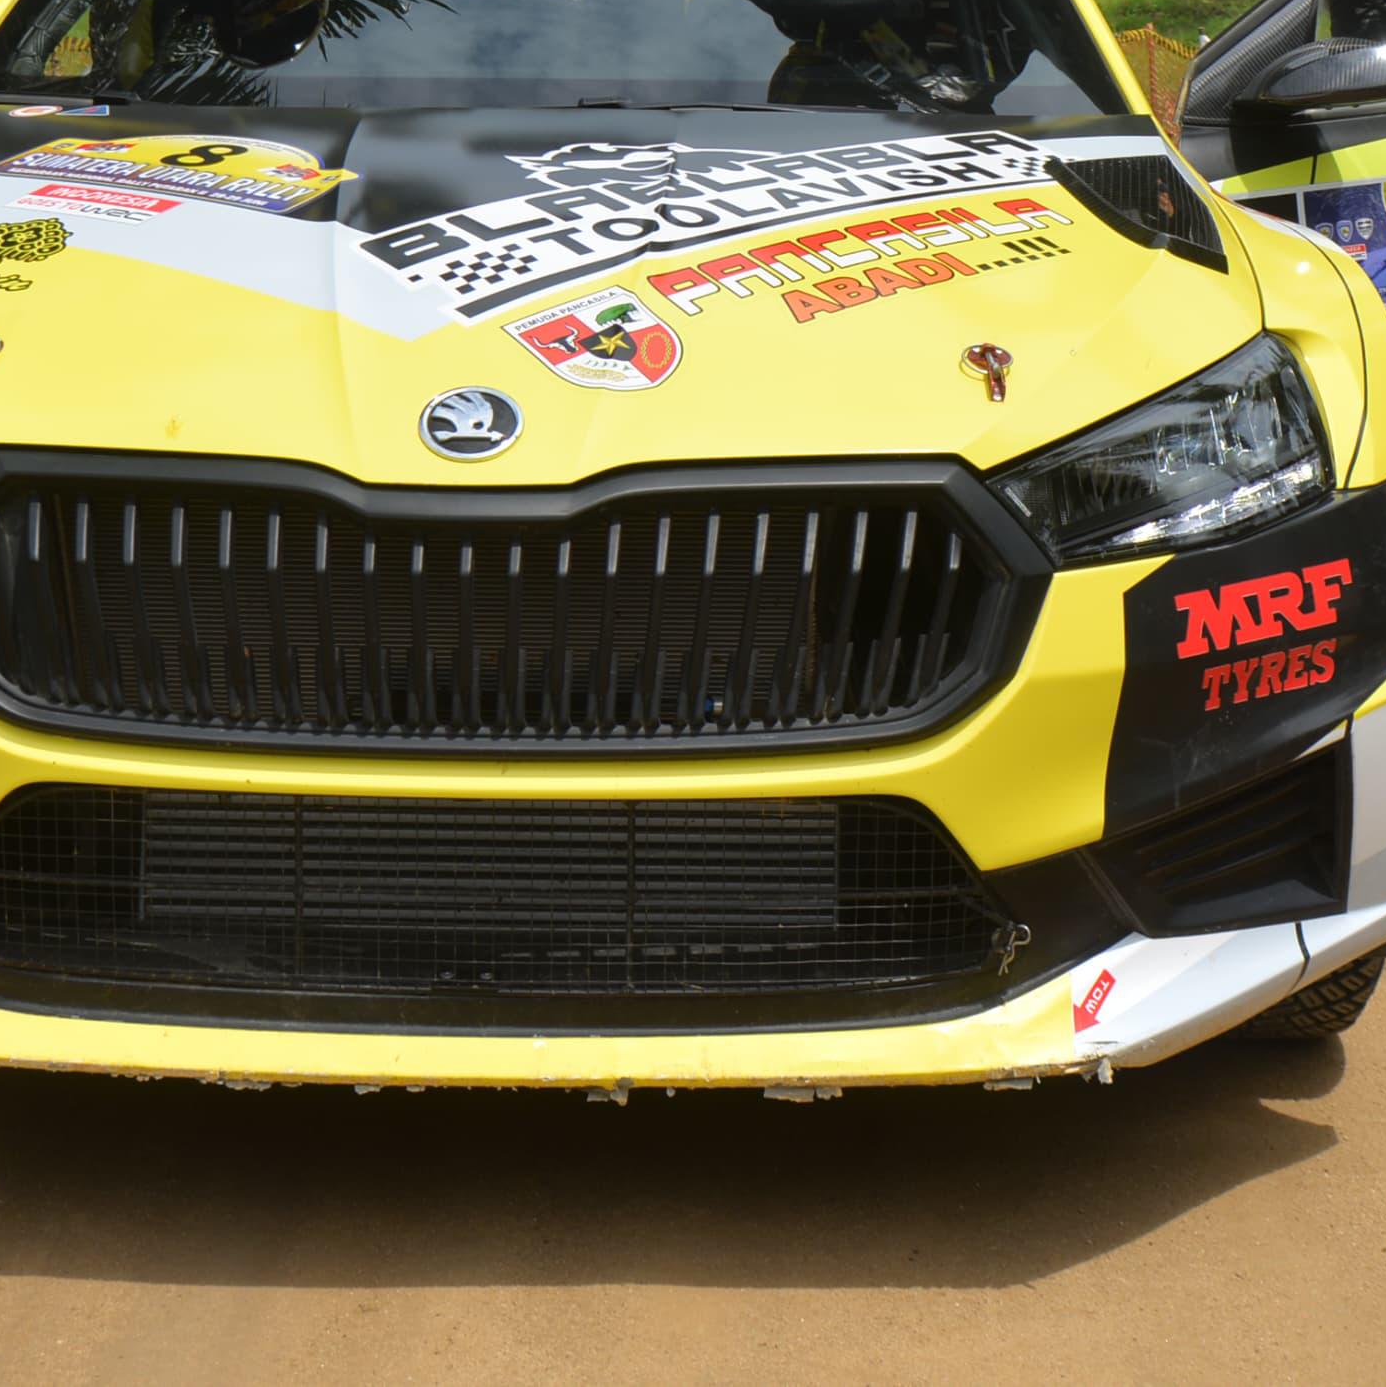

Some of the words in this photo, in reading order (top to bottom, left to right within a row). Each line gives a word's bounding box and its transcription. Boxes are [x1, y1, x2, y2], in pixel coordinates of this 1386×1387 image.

[13, 152, 148, 177] SUMATERA
[138, 164, 226, 189] UTARA
[220, 174, 316, 201] RALLY
[159, 144, 249, 167] 8
[46, 186, 161, 210] INDONESIA
[377, 129, 1041, 271] BLABLABLA
[528, 160, 1001, 257] TOOLAVISH
[646, 198, 1073, 316] PANCASILA
[515, 311, 558, 332] PEMUDA
[559, 291, 618, 315] PANCASILA
[1174, 557, 1353, 660] MRF
[1201, 638, 1338, 712] TYRES
[1085, 977, 1111, 1014] TOW
